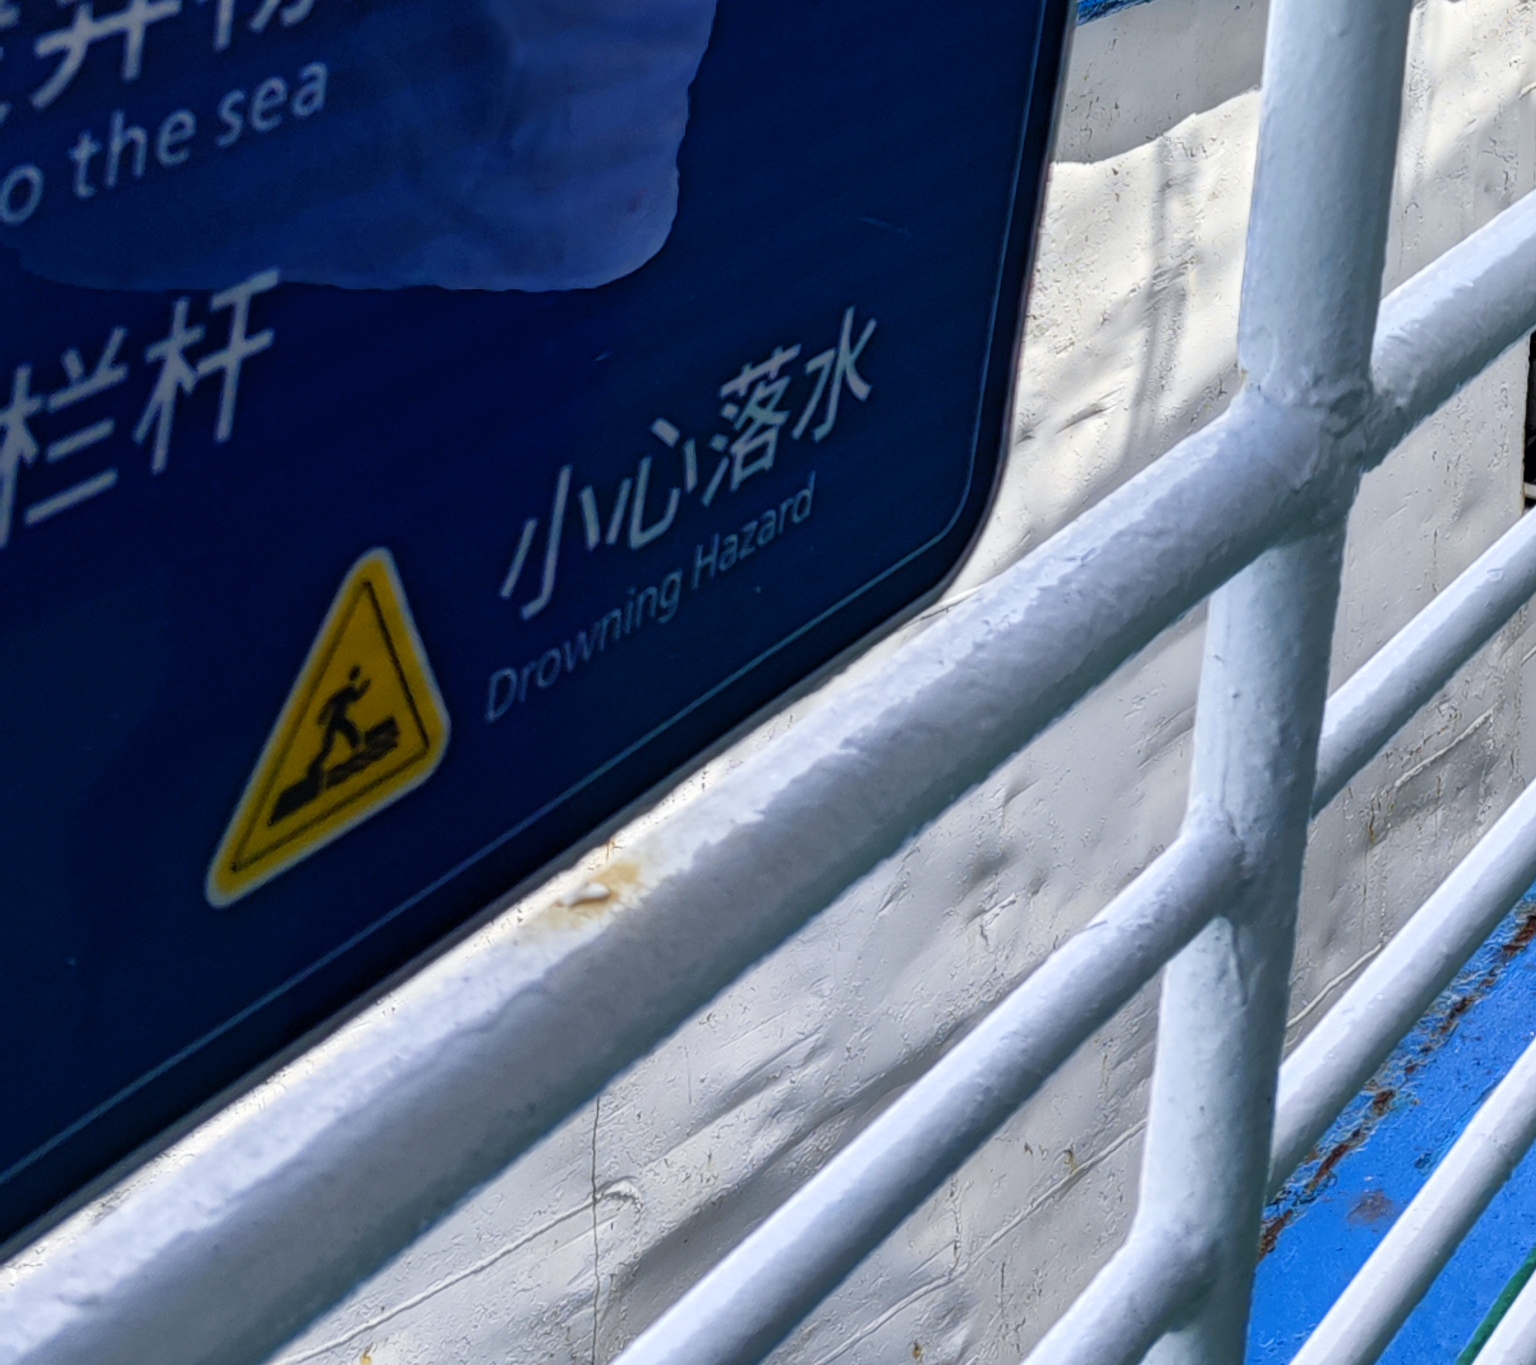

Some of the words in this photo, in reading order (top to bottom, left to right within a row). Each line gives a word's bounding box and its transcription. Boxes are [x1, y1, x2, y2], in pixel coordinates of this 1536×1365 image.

[68, 108, 197, 200] the
[215, 61, 329, 148] sea
[0, 267, 280, 550] 栏杆
[499, 305, 878, 622] 小心落水
[484, 569, 683, 724] Drowning
[691, 470, 816, 590] Hazard
